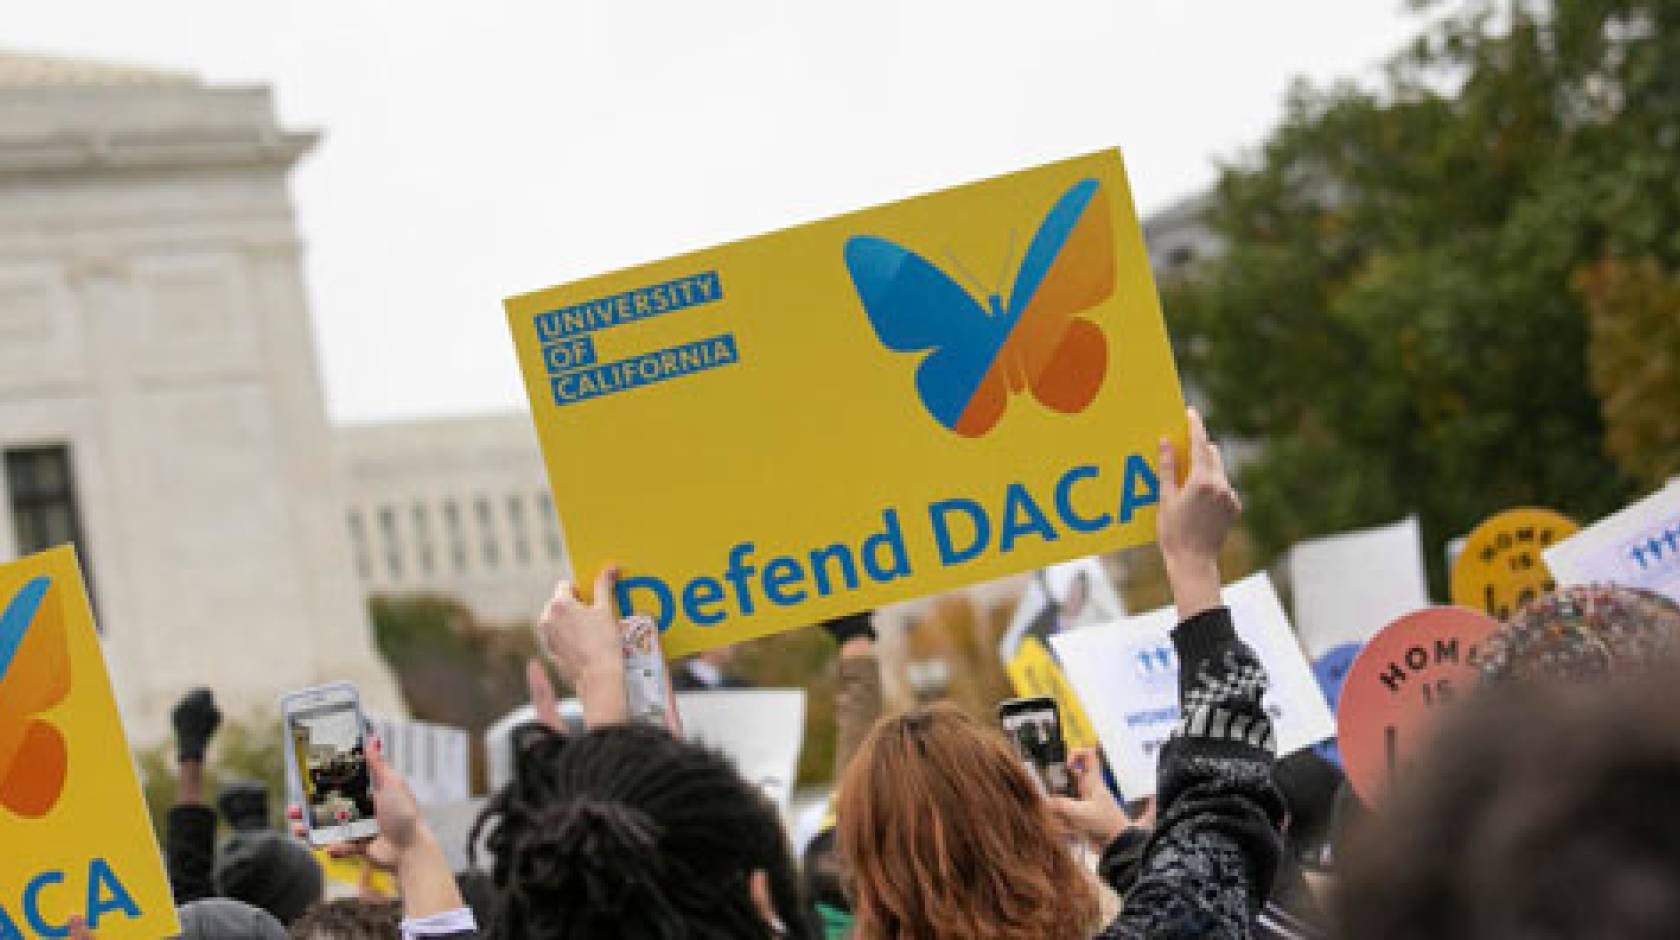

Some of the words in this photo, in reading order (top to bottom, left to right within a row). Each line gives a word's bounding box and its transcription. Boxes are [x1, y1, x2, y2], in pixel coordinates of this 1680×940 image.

[540, 276, 715, 337] UNIVERSITY
[550, 342, 588, 370] OF
[556, 340, 731, 401] CALIFORNIA
[615, 507, 912, 632] Defend
[928, 455, 1161, 567] DACA
[0, 857, 142, 940] CA
